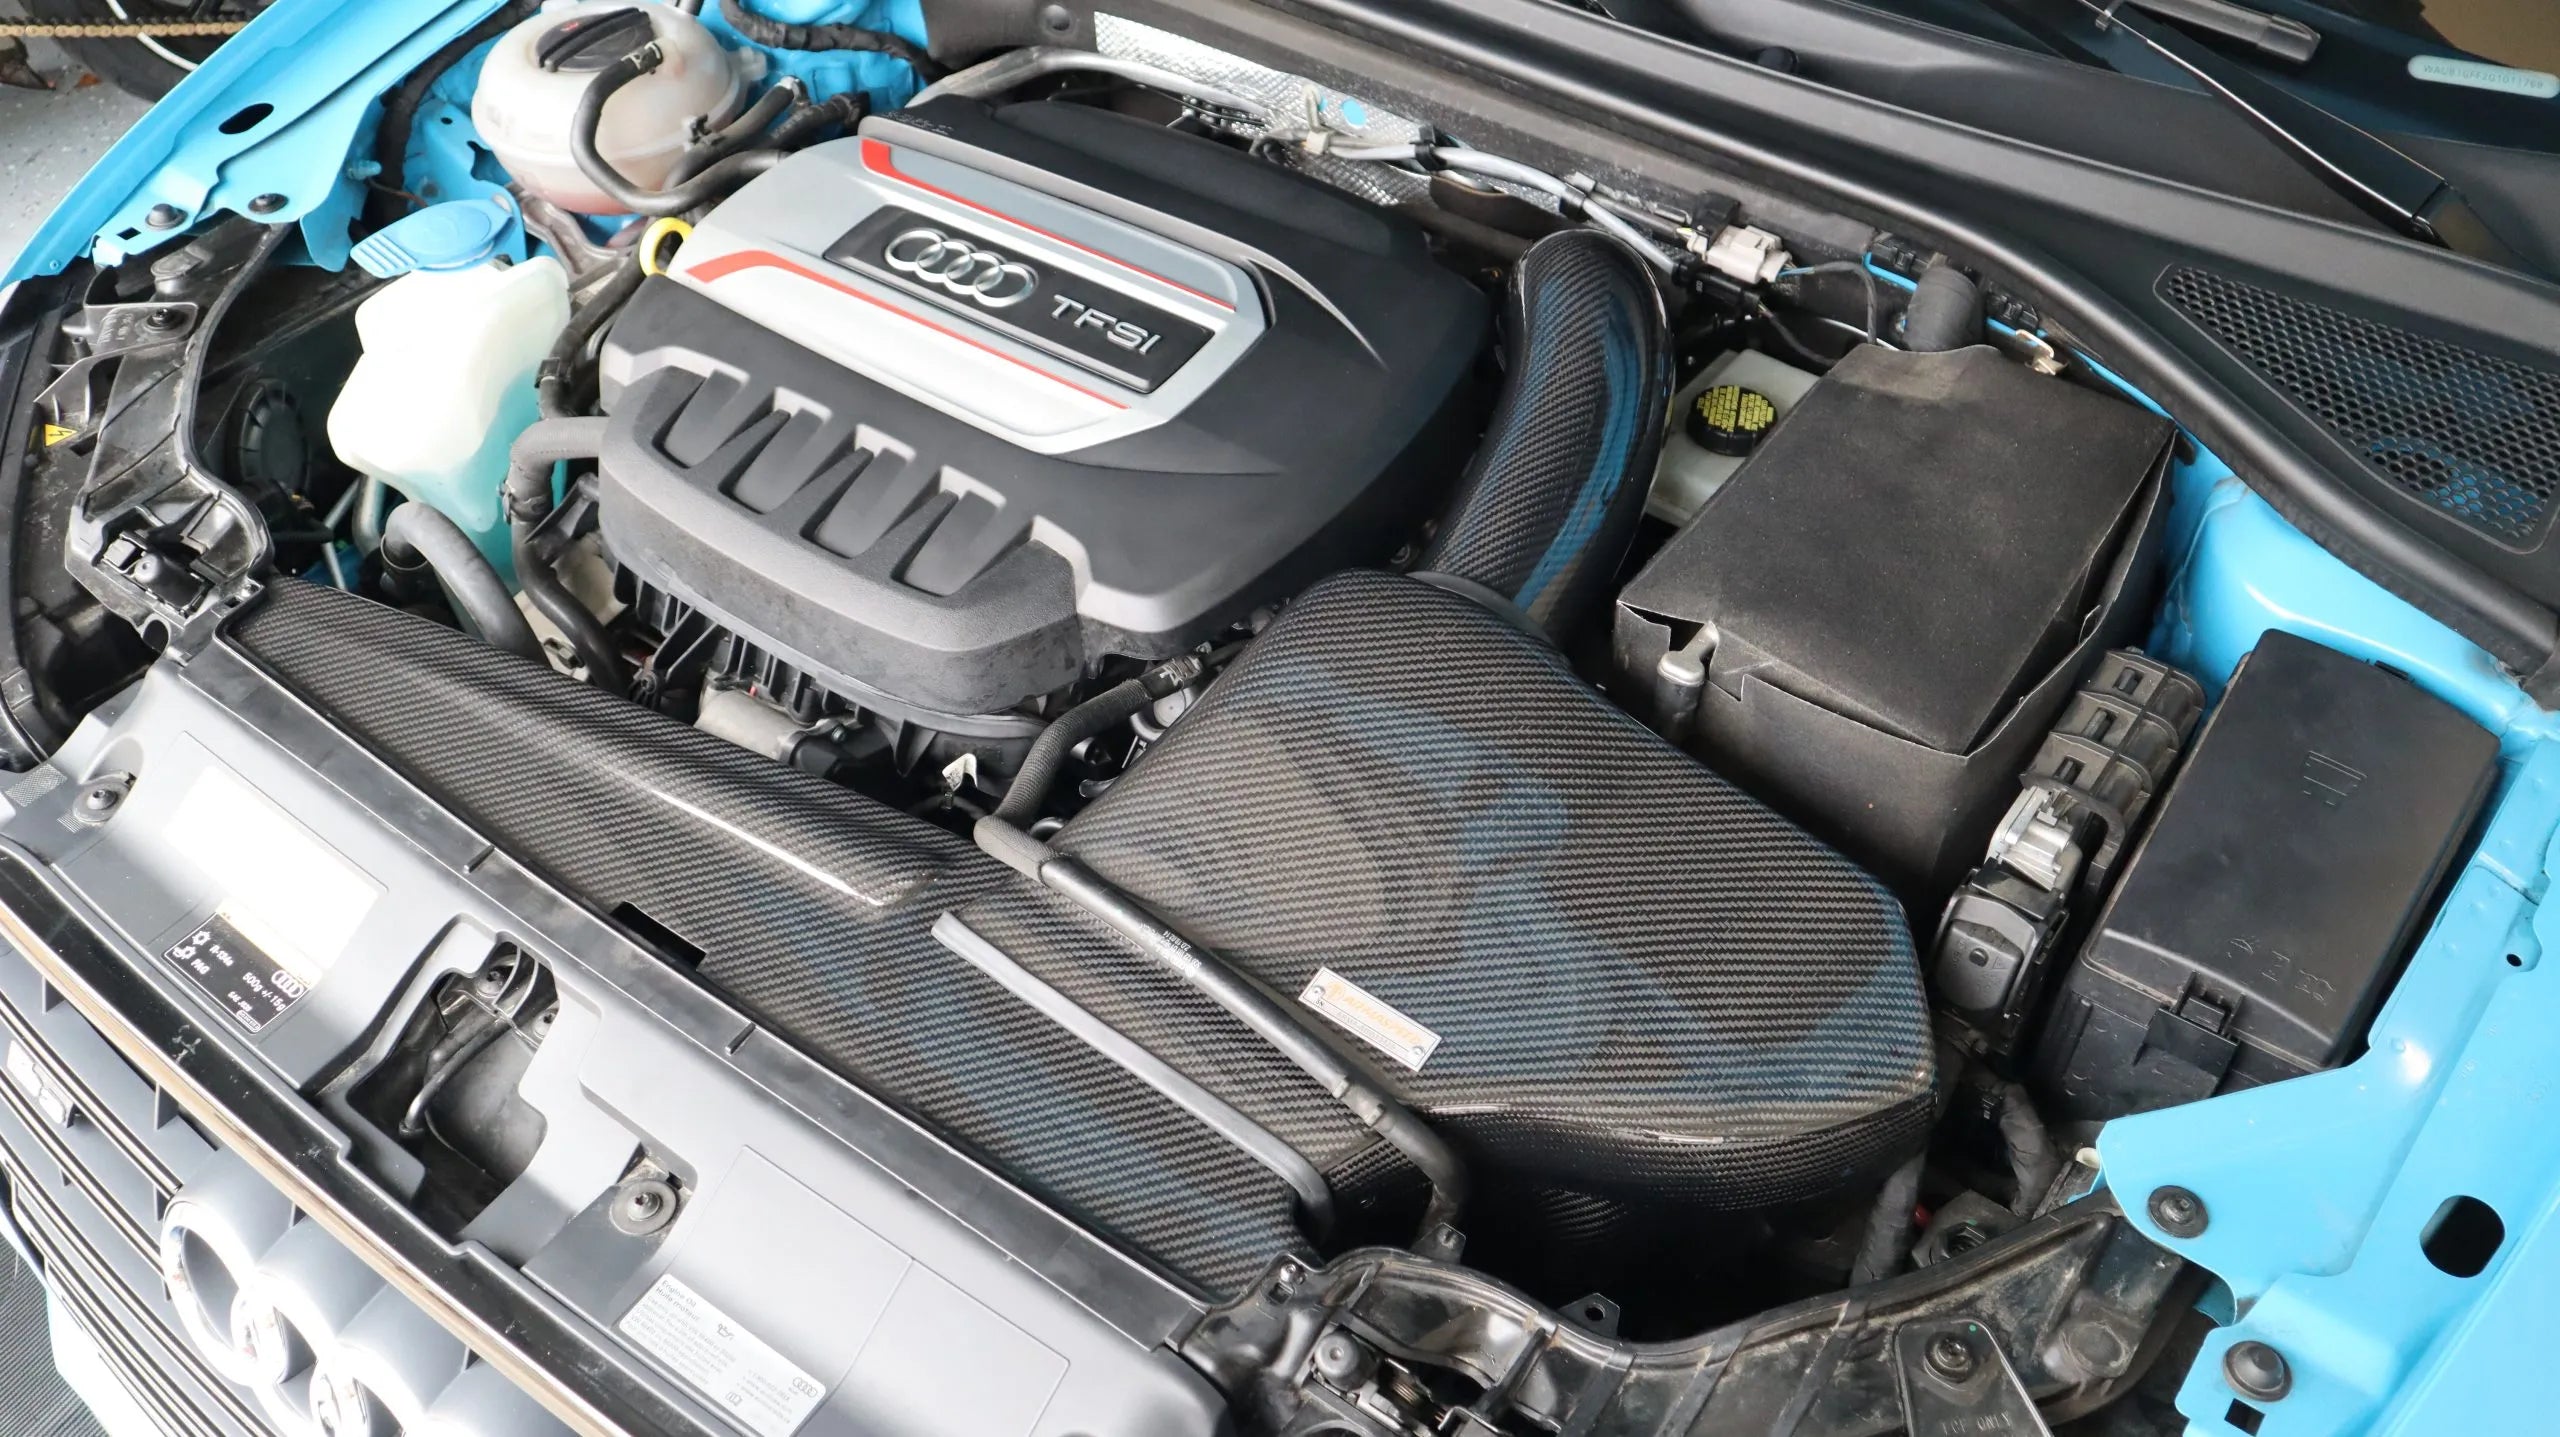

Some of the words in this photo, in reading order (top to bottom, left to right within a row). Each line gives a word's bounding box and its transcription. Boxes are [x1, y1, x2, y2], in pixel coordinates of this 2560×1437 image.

[1050, 293, 1162, 355] TFSI
[191, 958, 210, 974] PAG
[242, 971, 263, 992] 500g
[662, 1280, 685, 1299] Engine
[656, 1287, 673, 1302] Huile
[673, 1301, 700, 1321] moteur
